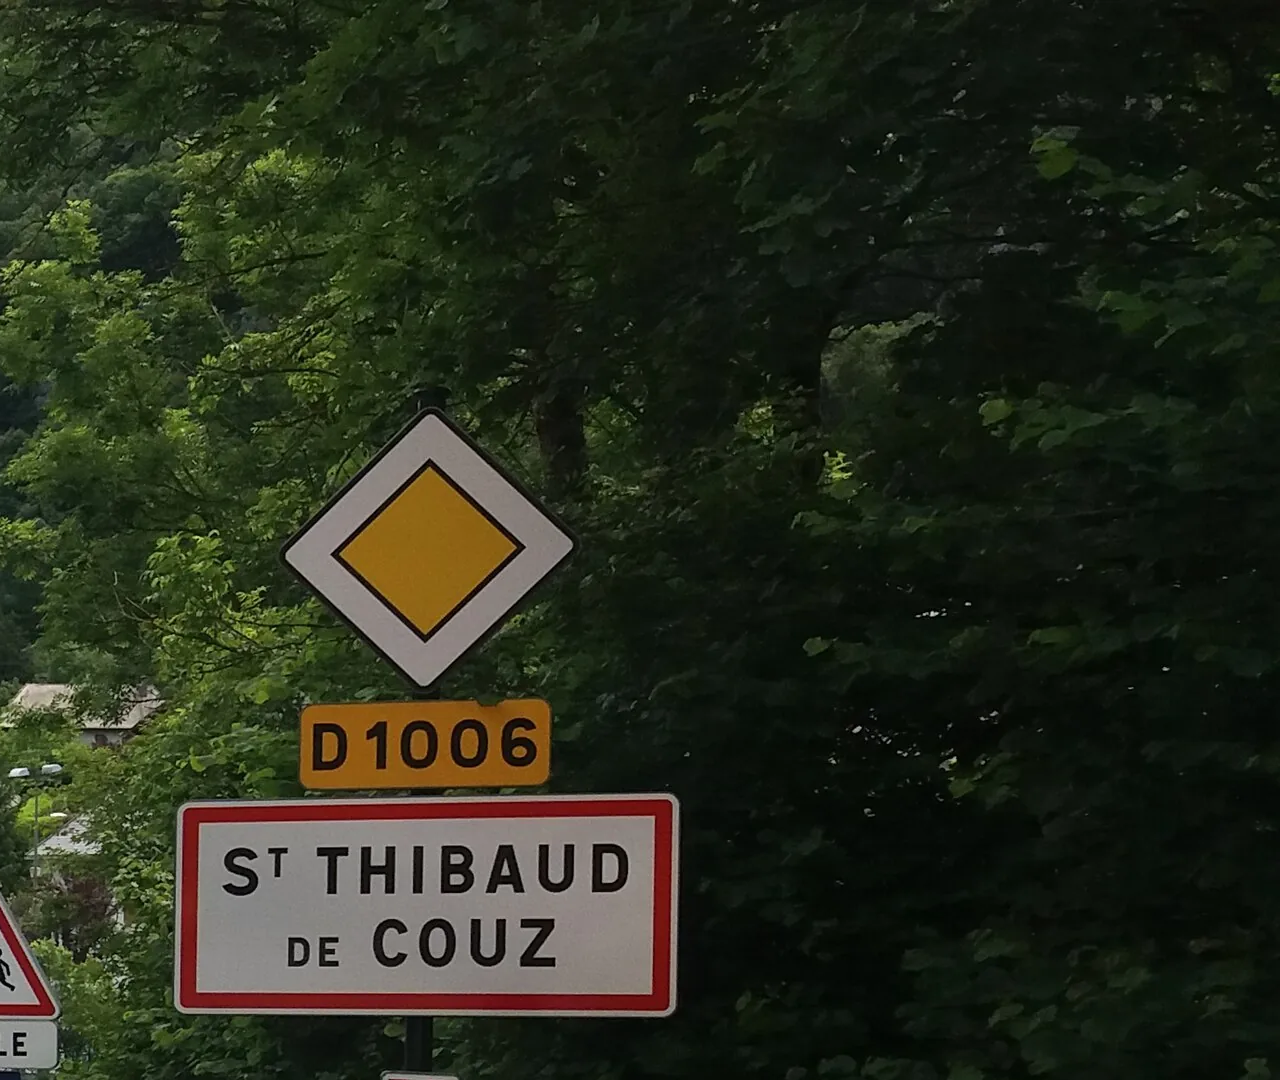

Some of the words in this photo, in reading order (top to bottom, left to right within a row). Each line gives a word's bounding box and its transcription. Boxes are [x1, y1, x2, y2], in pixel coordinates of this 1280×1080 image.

[222, 847, 288, 896] ST
[317, 843, 629, 895] THIBAUD
[287, 937, 339, 967] DE
[372, 918, 556, 968] COUZ
